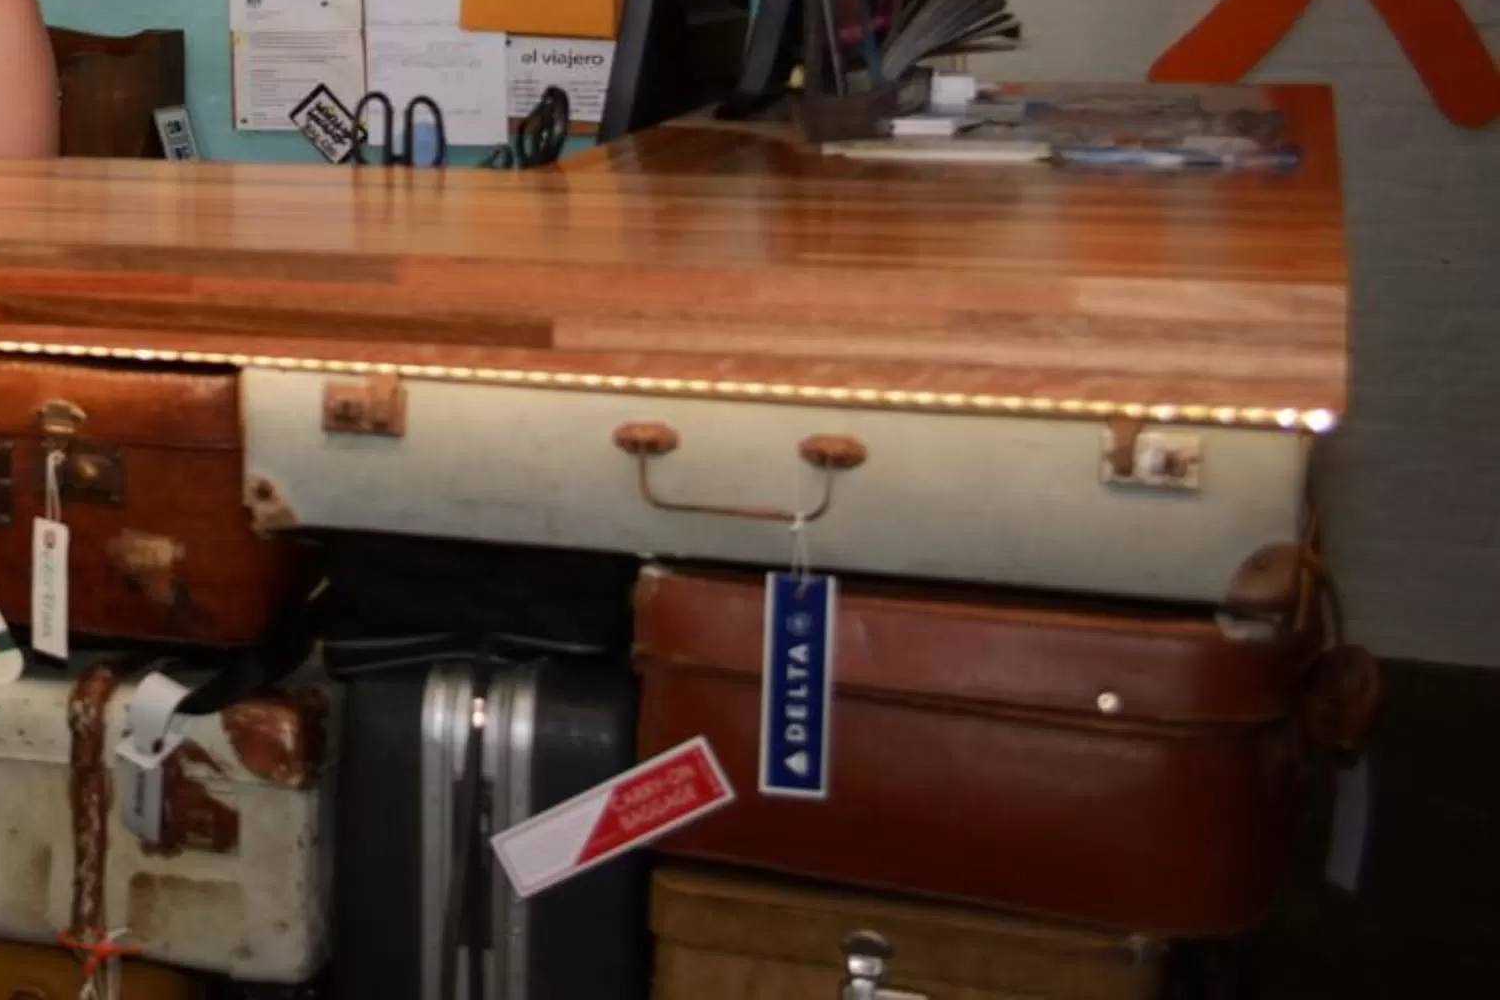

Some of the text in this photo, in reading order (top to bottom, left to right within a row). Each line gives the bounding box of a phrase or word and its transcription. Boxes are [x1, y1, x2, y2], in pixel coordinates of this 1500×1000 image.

[520, 47, 605, 69] el viajero
[783, 642, 810, 743] DELTA
